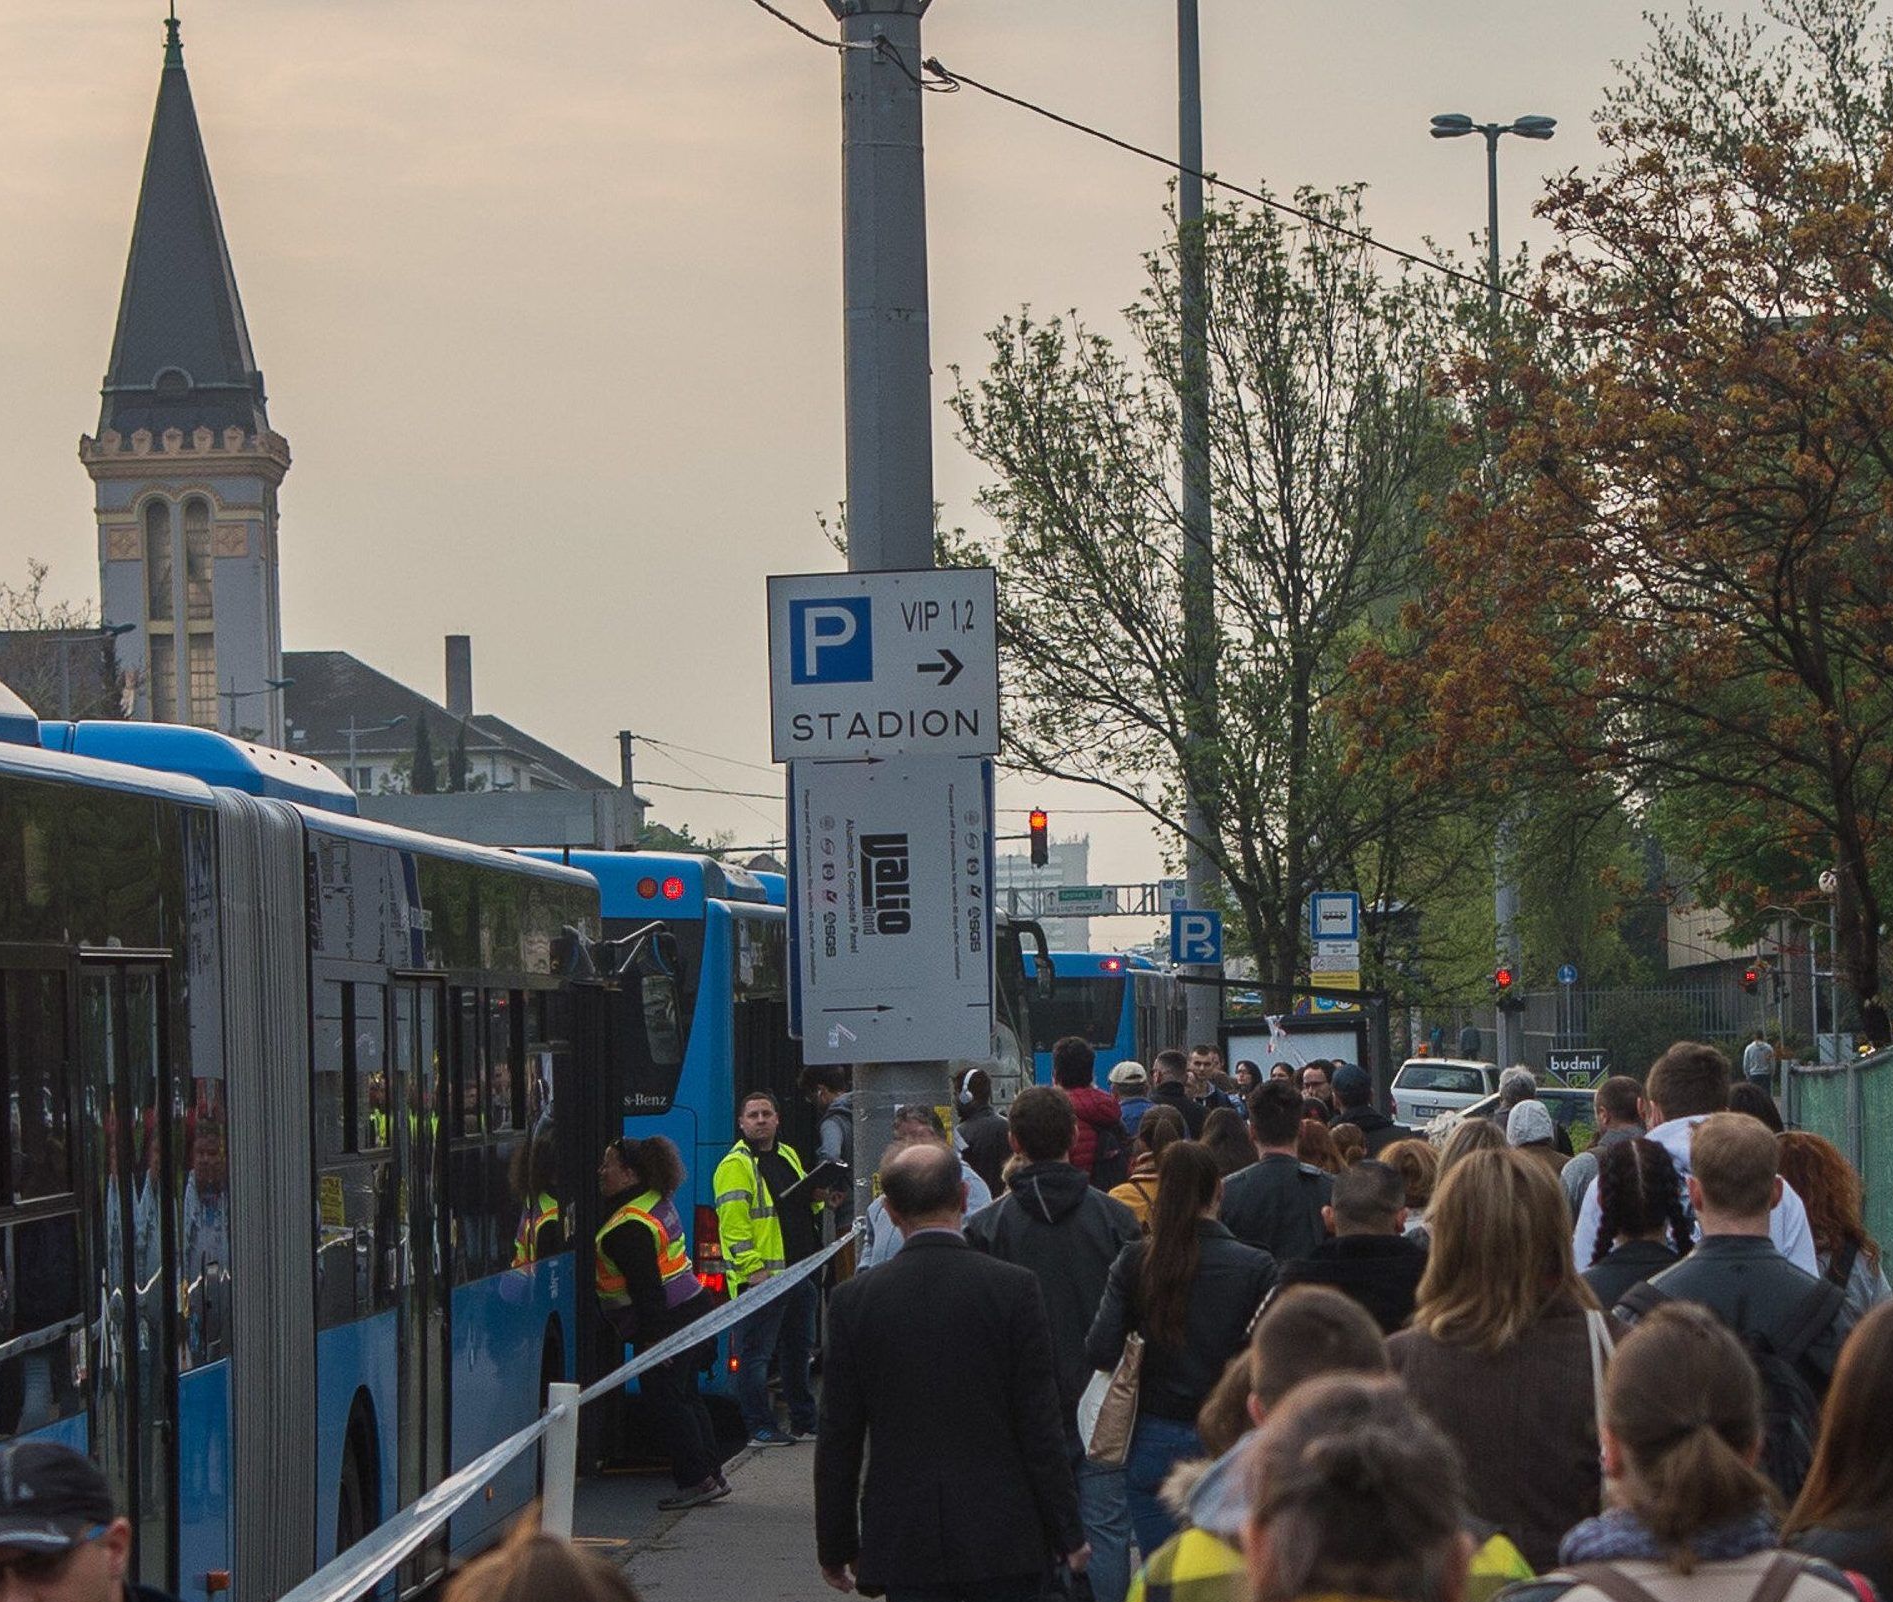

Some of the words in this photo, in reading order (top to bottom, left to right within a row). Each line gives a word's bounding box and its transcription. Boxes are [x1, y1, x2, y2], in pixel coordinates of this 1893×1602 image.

[901, 601, 939, 632] VIP
[951, 599, 974, 633] 1,2
[805, 606, 857, 676] P
[792, 708, 980, 741] STADION
[849, 926, 859, 954] Panel
[1179, 915, 1212, 959] P
[1550, 1055, 1601, 1070] budmil
[623, 1092, 668, 1106] s-Benz
